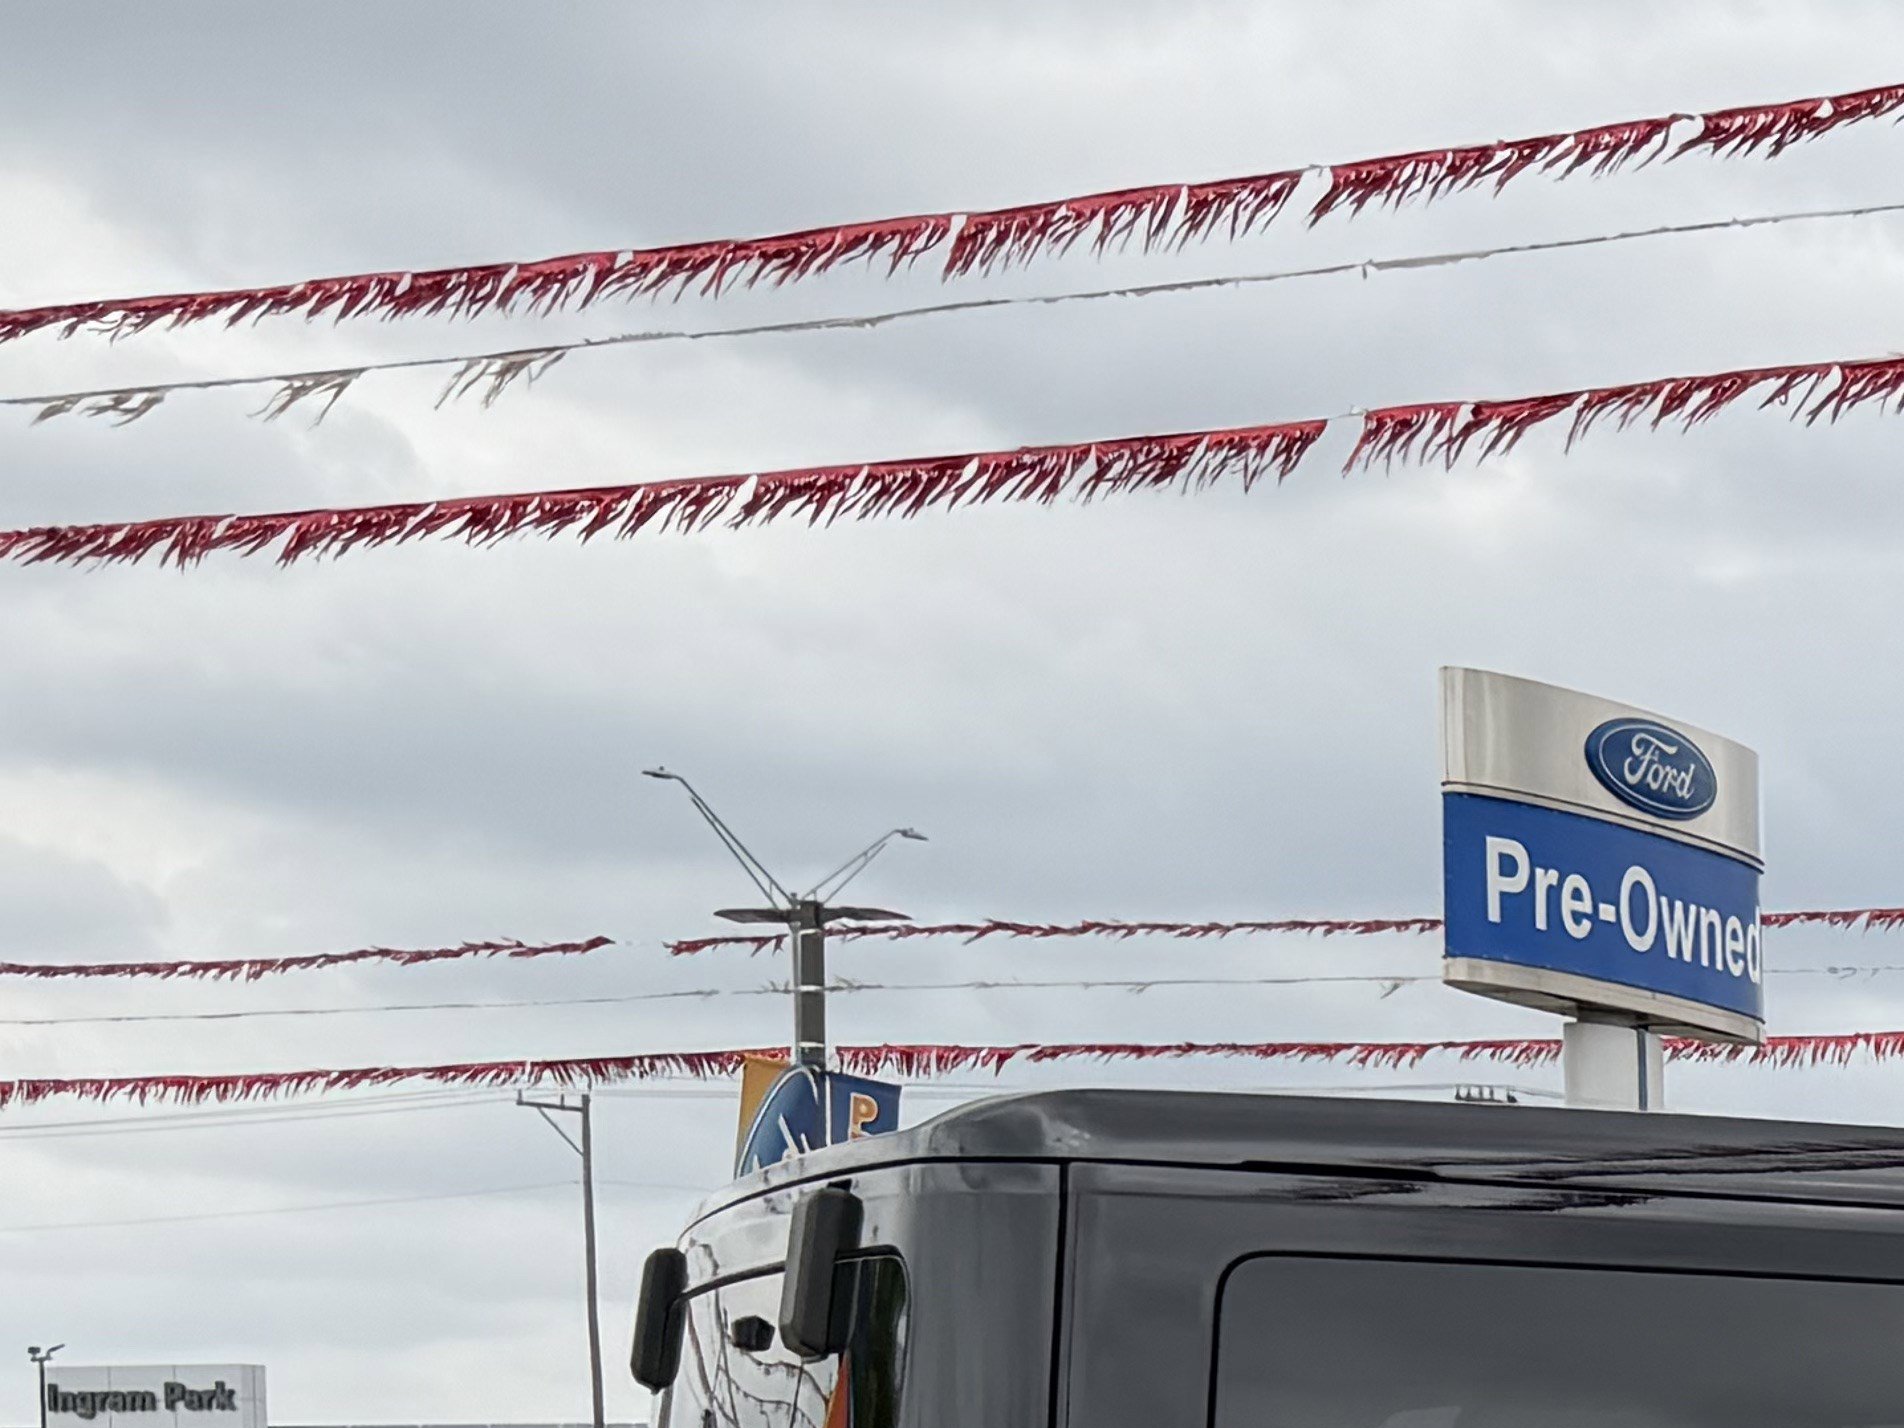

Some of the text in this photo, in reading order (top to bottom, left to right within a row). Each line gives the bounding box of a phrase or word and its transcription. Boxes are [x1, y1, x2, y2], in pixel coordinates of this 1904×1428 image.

[1624, 732, 1695, 799] Ford
[1486, 835, 1761, 984] Pre-Owned
[48, 1381, 238, 1420] Ingram Park
